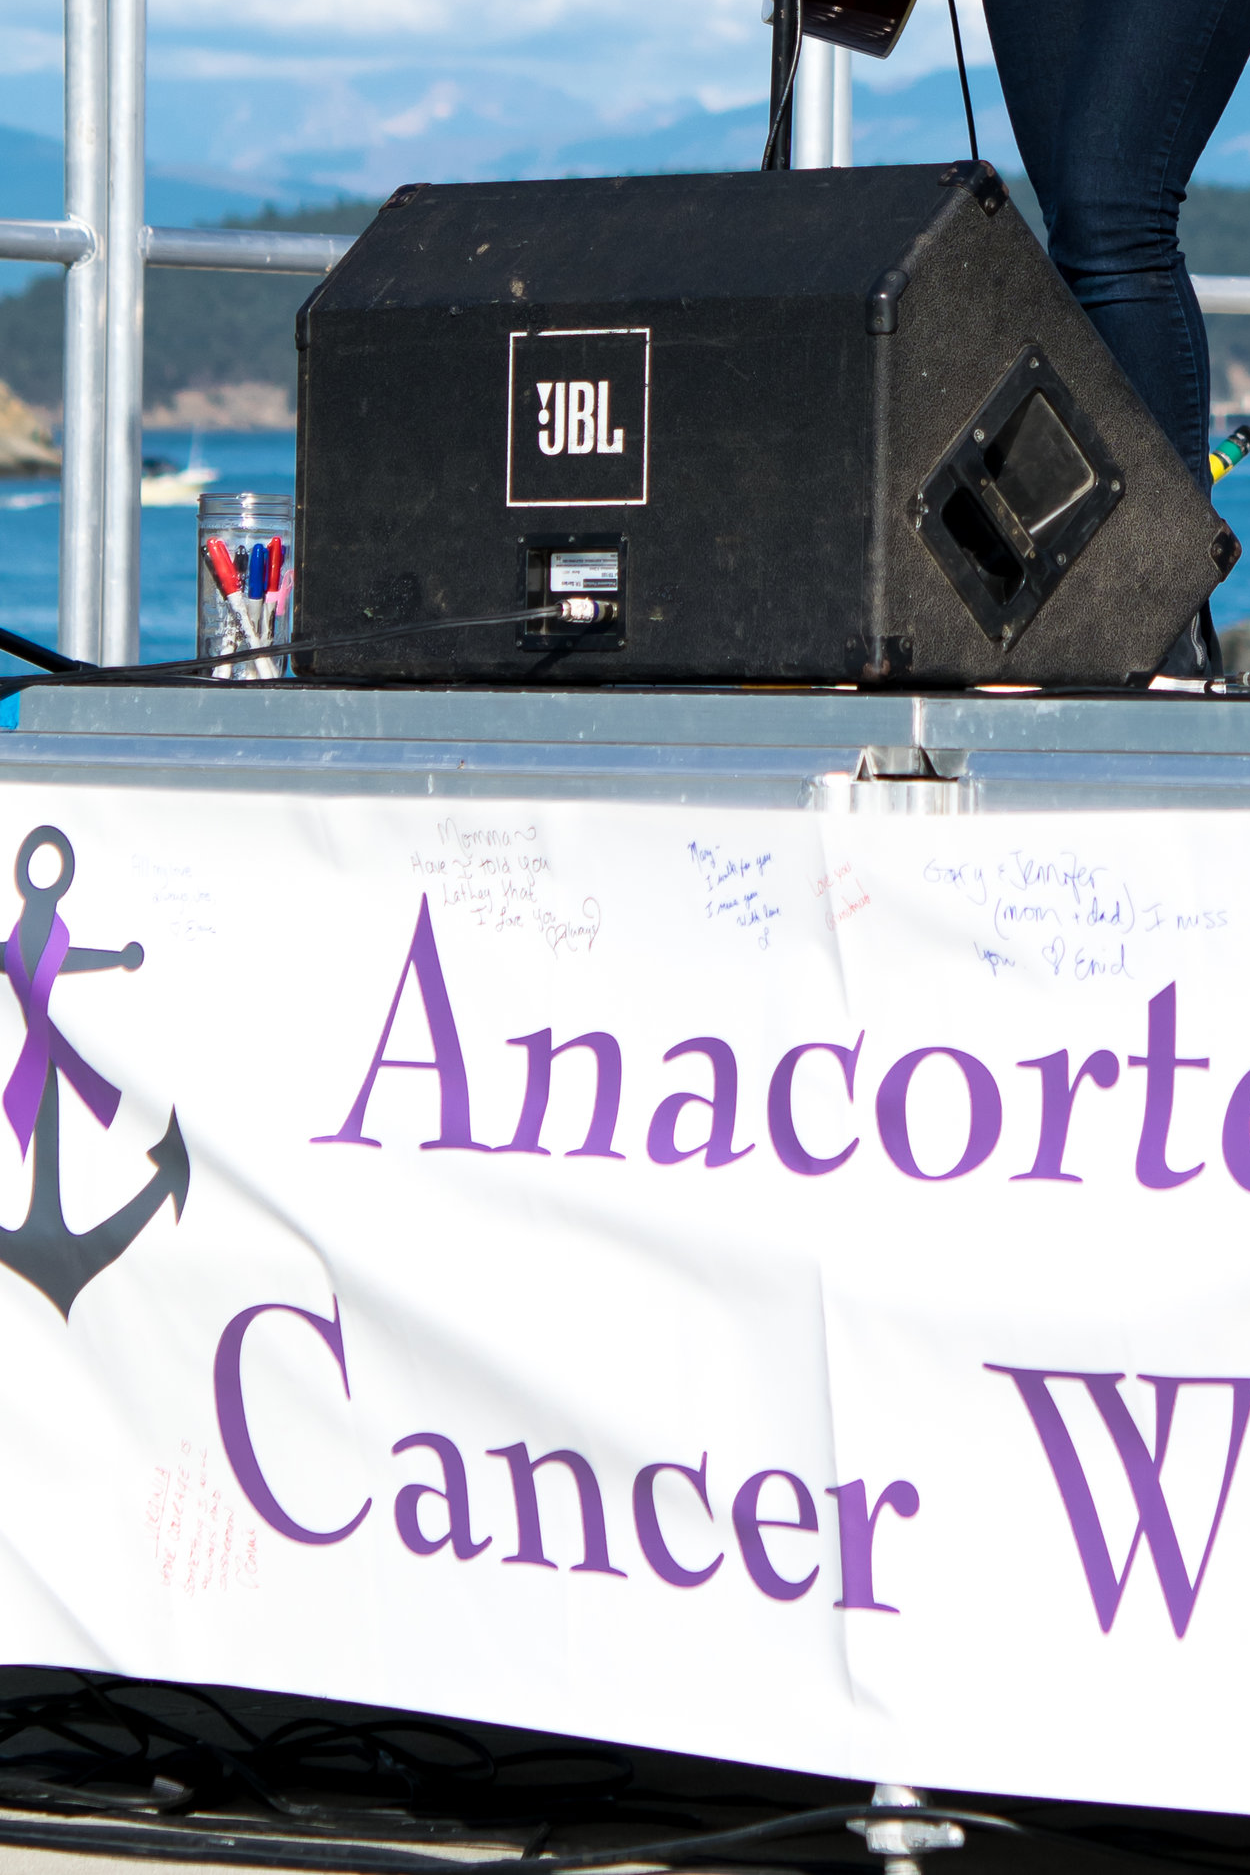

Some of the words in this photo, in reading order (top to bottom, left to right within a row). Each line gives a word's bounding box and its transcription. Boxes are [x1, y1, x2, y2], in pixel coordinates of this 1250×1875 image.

[536, 381, 625, 456] JBL
[479, 855, 511, 876] told
[922, 857, 988, 906] Gary
[1008, 849, 1110, 906] Jennifer
[1175, 909, 1230, 931] miss
[214, 1296, 921, 1614] Cancer
